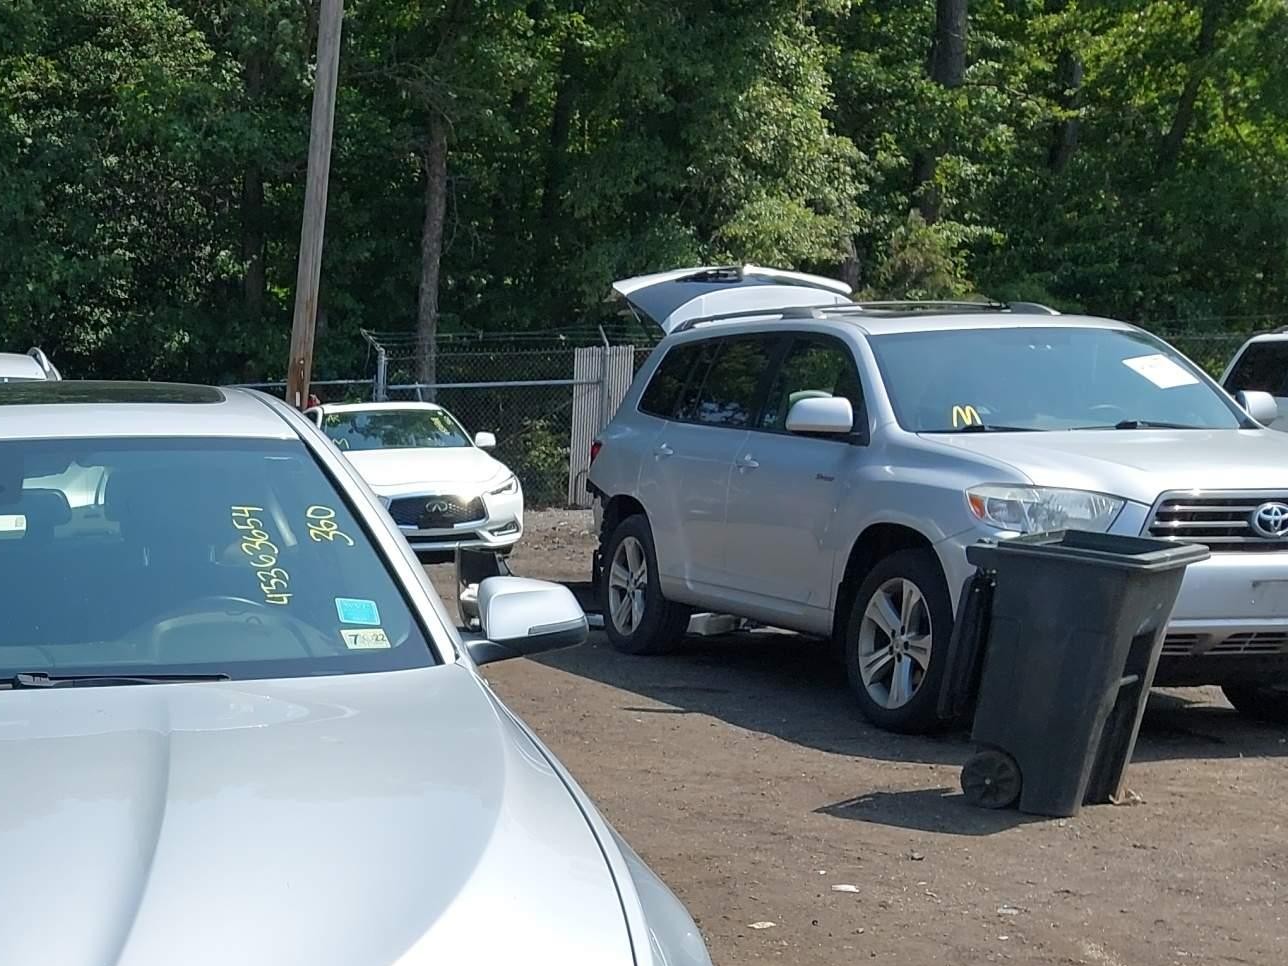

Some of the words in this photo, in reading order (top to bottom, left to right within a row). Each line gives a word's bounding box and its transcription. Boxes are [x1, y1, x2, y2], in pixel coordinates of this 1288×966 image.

[952, 405, 983, 428] M
[306, 505, 355, 546] 360
[231, 505, 294, 605] 45363654
